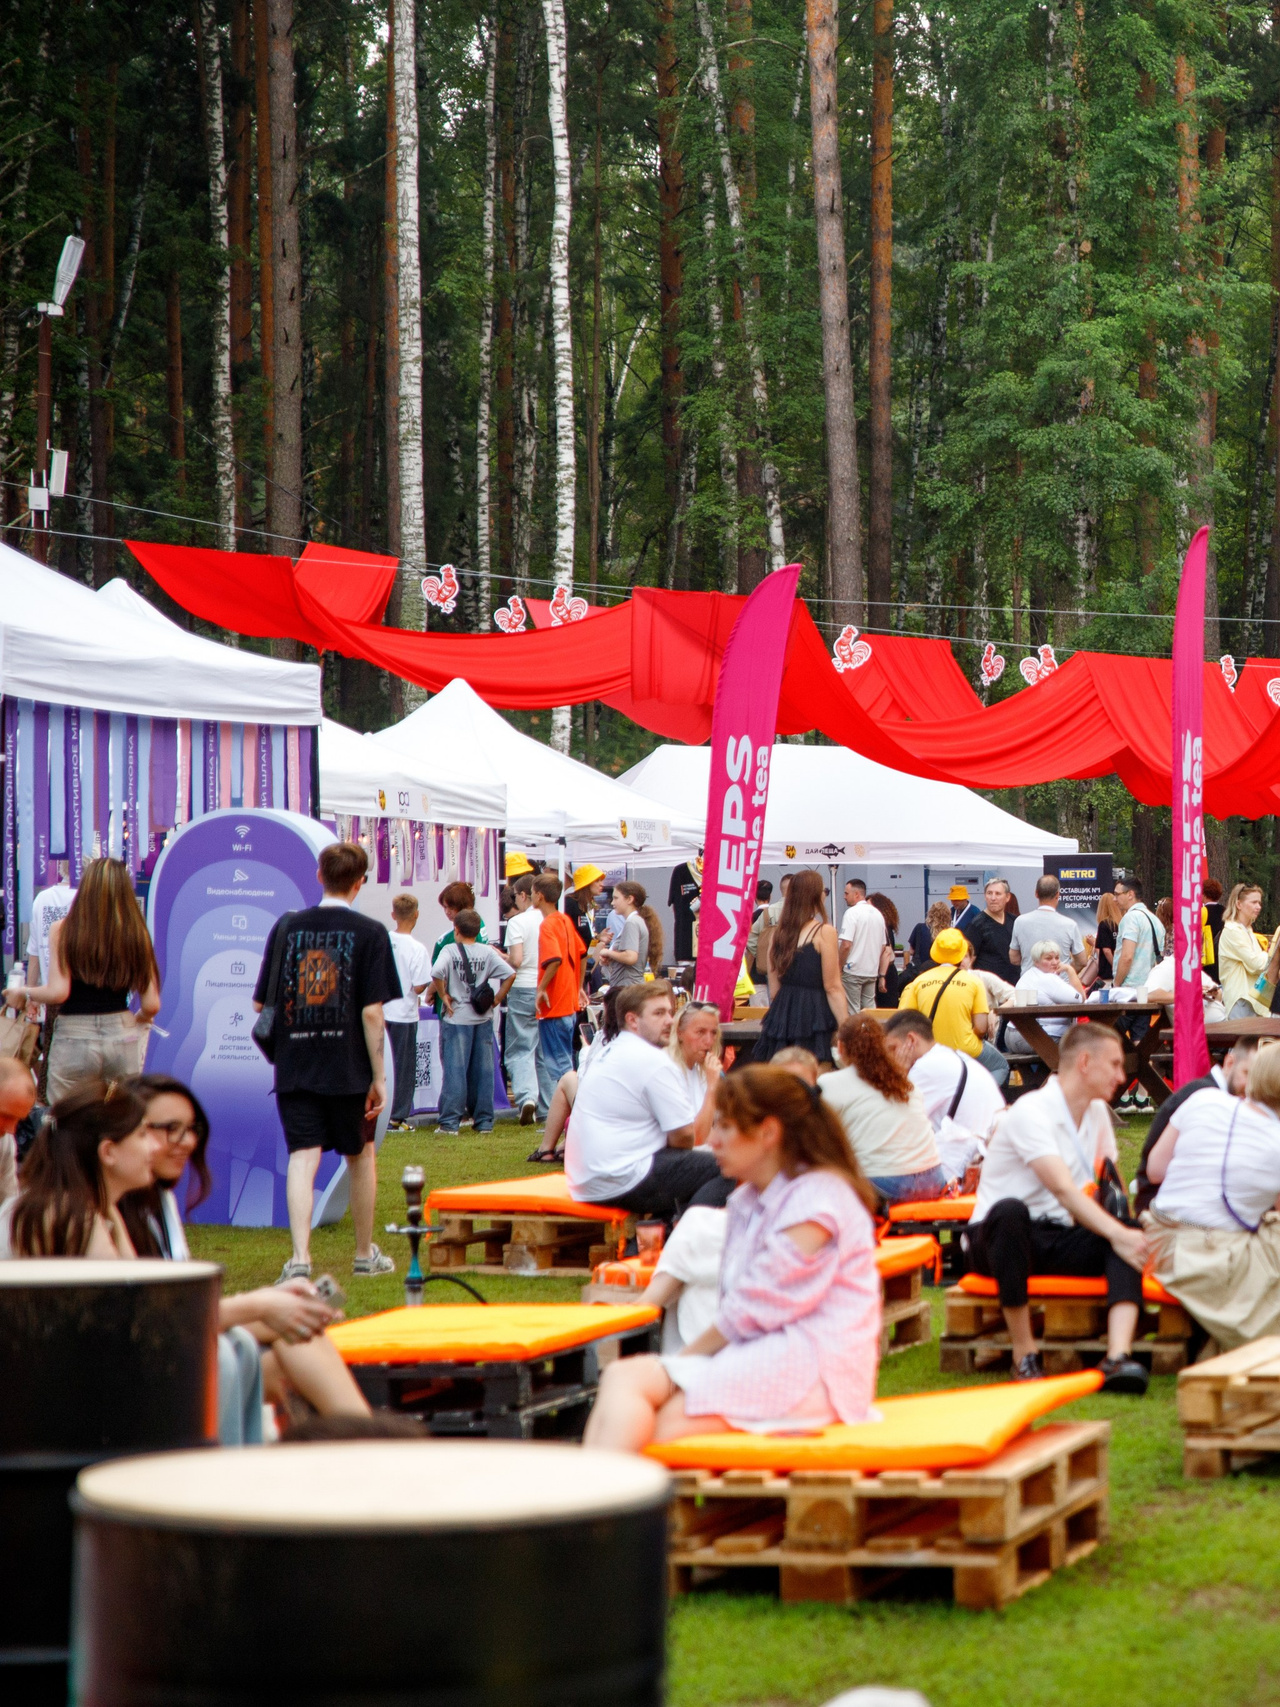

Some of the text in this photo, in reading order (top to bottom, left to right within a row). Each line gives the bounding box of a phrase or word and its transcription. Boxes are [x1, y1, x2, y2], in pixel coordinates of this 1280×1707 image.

[127, 734, 135, 819] ПАРКОВКА
[752, 745, 769, 807] tea
[1191, 736, 1203, 808] tea
[71, 707, 82, 881] ИНТЕРАКТИВНОЕ МЕН
[632, 820, 656, 832] МАГАЗИН
[635, 832, 654, 843] МЕРЧА
[231, 844, 252, 852] Wi-Fi
[712, 734, 753, 961] MEPS
[1060, 869, 1096, 879] METRO
[206, 887, 275, 897] Видеонаблюдение
[212, 933, 237, 941] Умные
[286, 930, 355, 949] STREETS
[452, 960, 486, 971] ATHETIC
[205, 980, 256, 989] Лицензионно
[222, 1033, 250, 1042] Сервис
